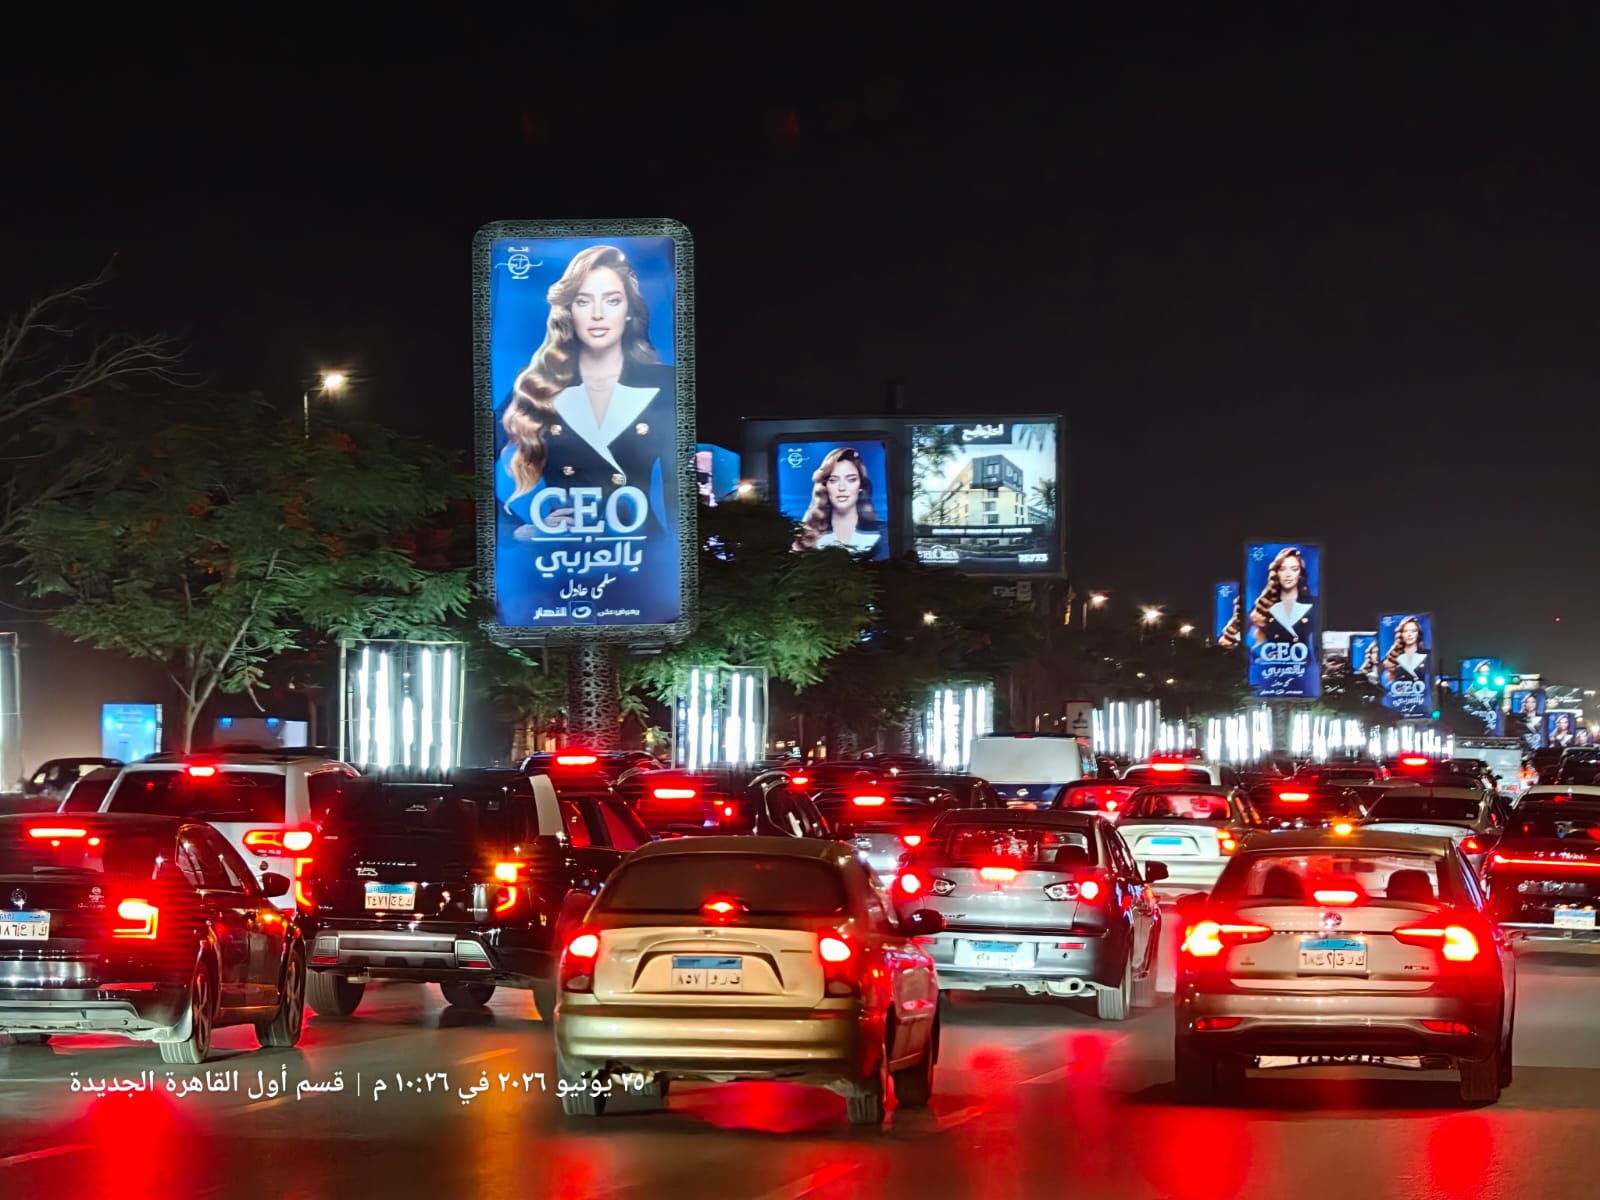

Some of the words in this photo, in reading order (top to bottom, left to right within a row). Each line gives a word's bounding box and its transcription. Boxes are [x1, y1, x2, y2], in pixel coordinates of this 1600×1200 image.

[530, 486, 649, 534] CEO
[535, 541, 643, 578] بالعربي
[533, 606, 567, 620] النهار
[1260, 641, 1309, 662] CEO
